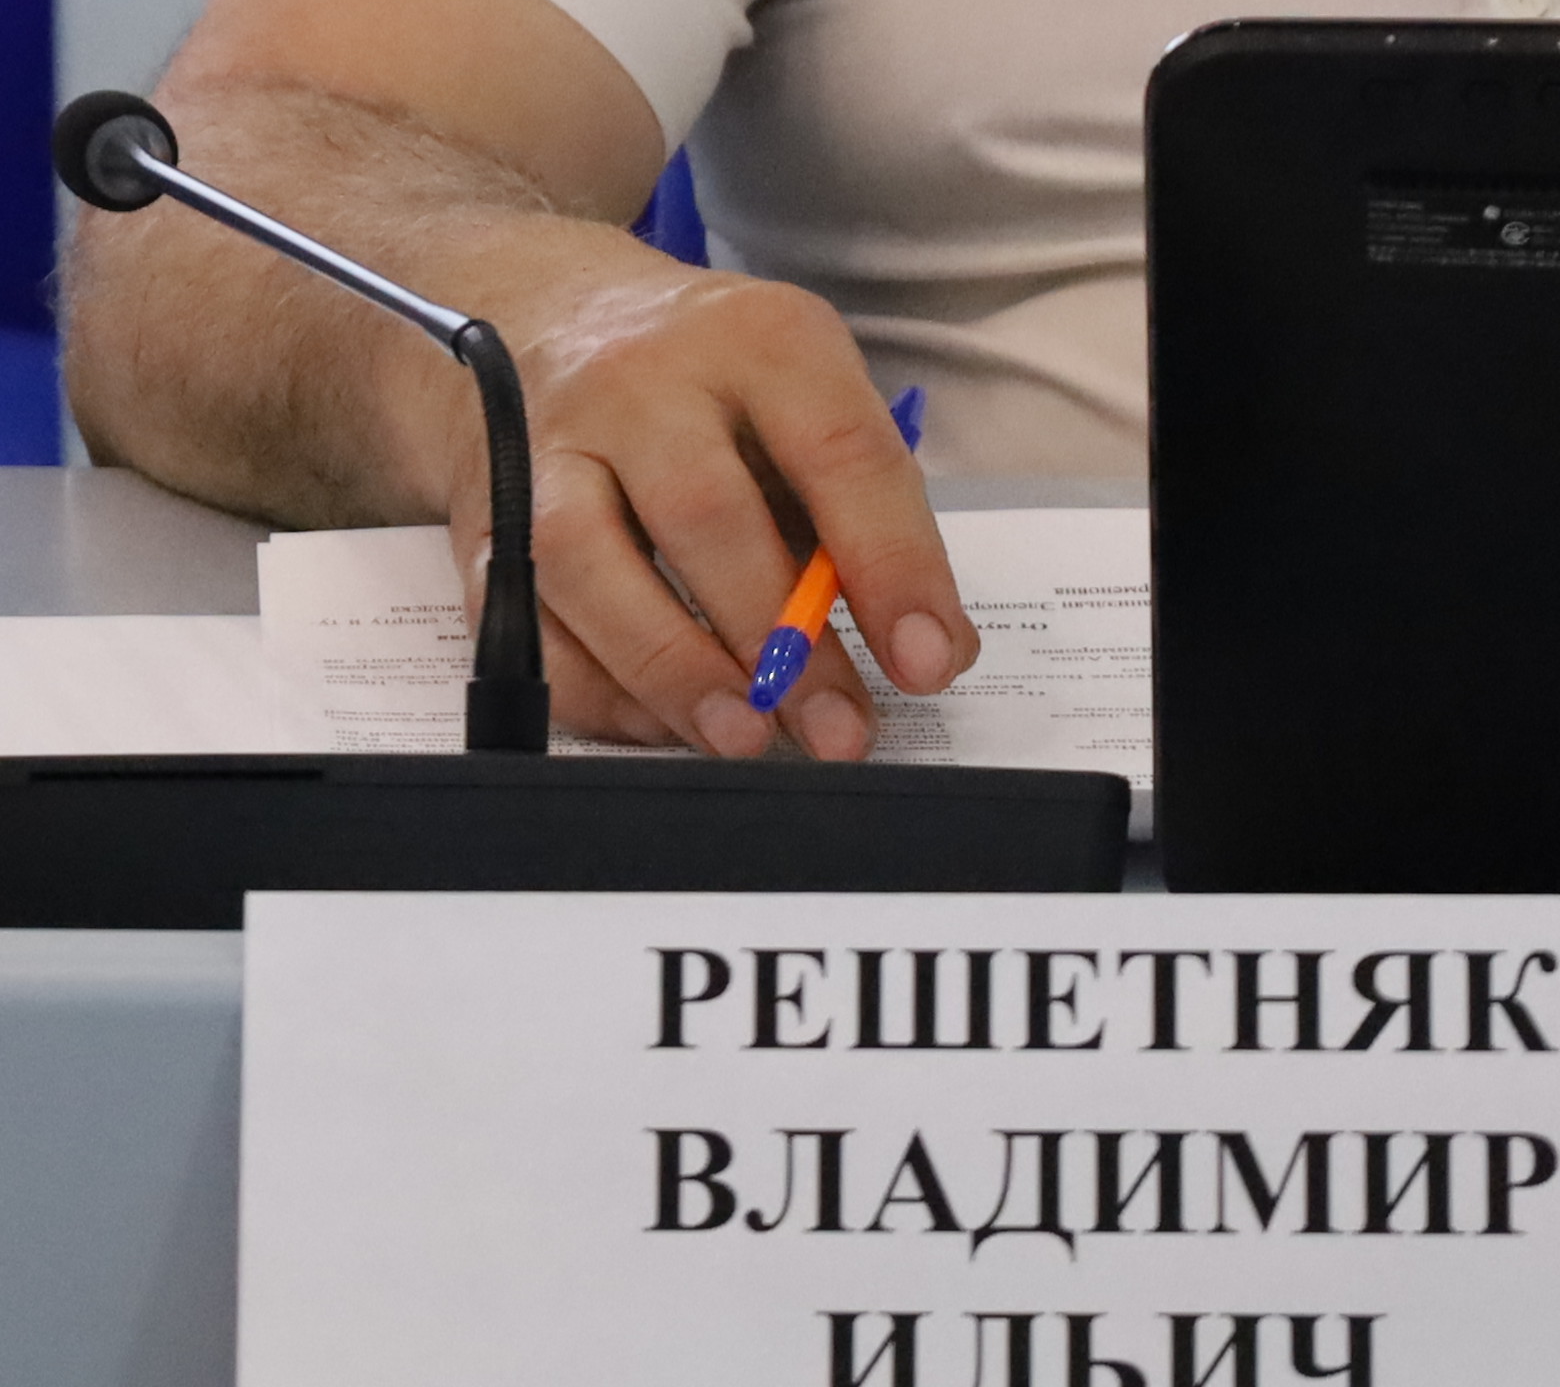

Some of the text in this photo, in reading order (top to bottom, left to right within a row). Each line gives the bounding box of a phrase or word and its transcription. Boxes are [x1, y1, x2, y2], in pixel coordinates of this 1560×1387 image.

[648, 948, 1558, 1052] РЕШЕТНЯК
[646, 1129, 1559, 1260] ВЛАДИМИР
[820, 1312, 1384, 1387] ИЛЬИЧ
